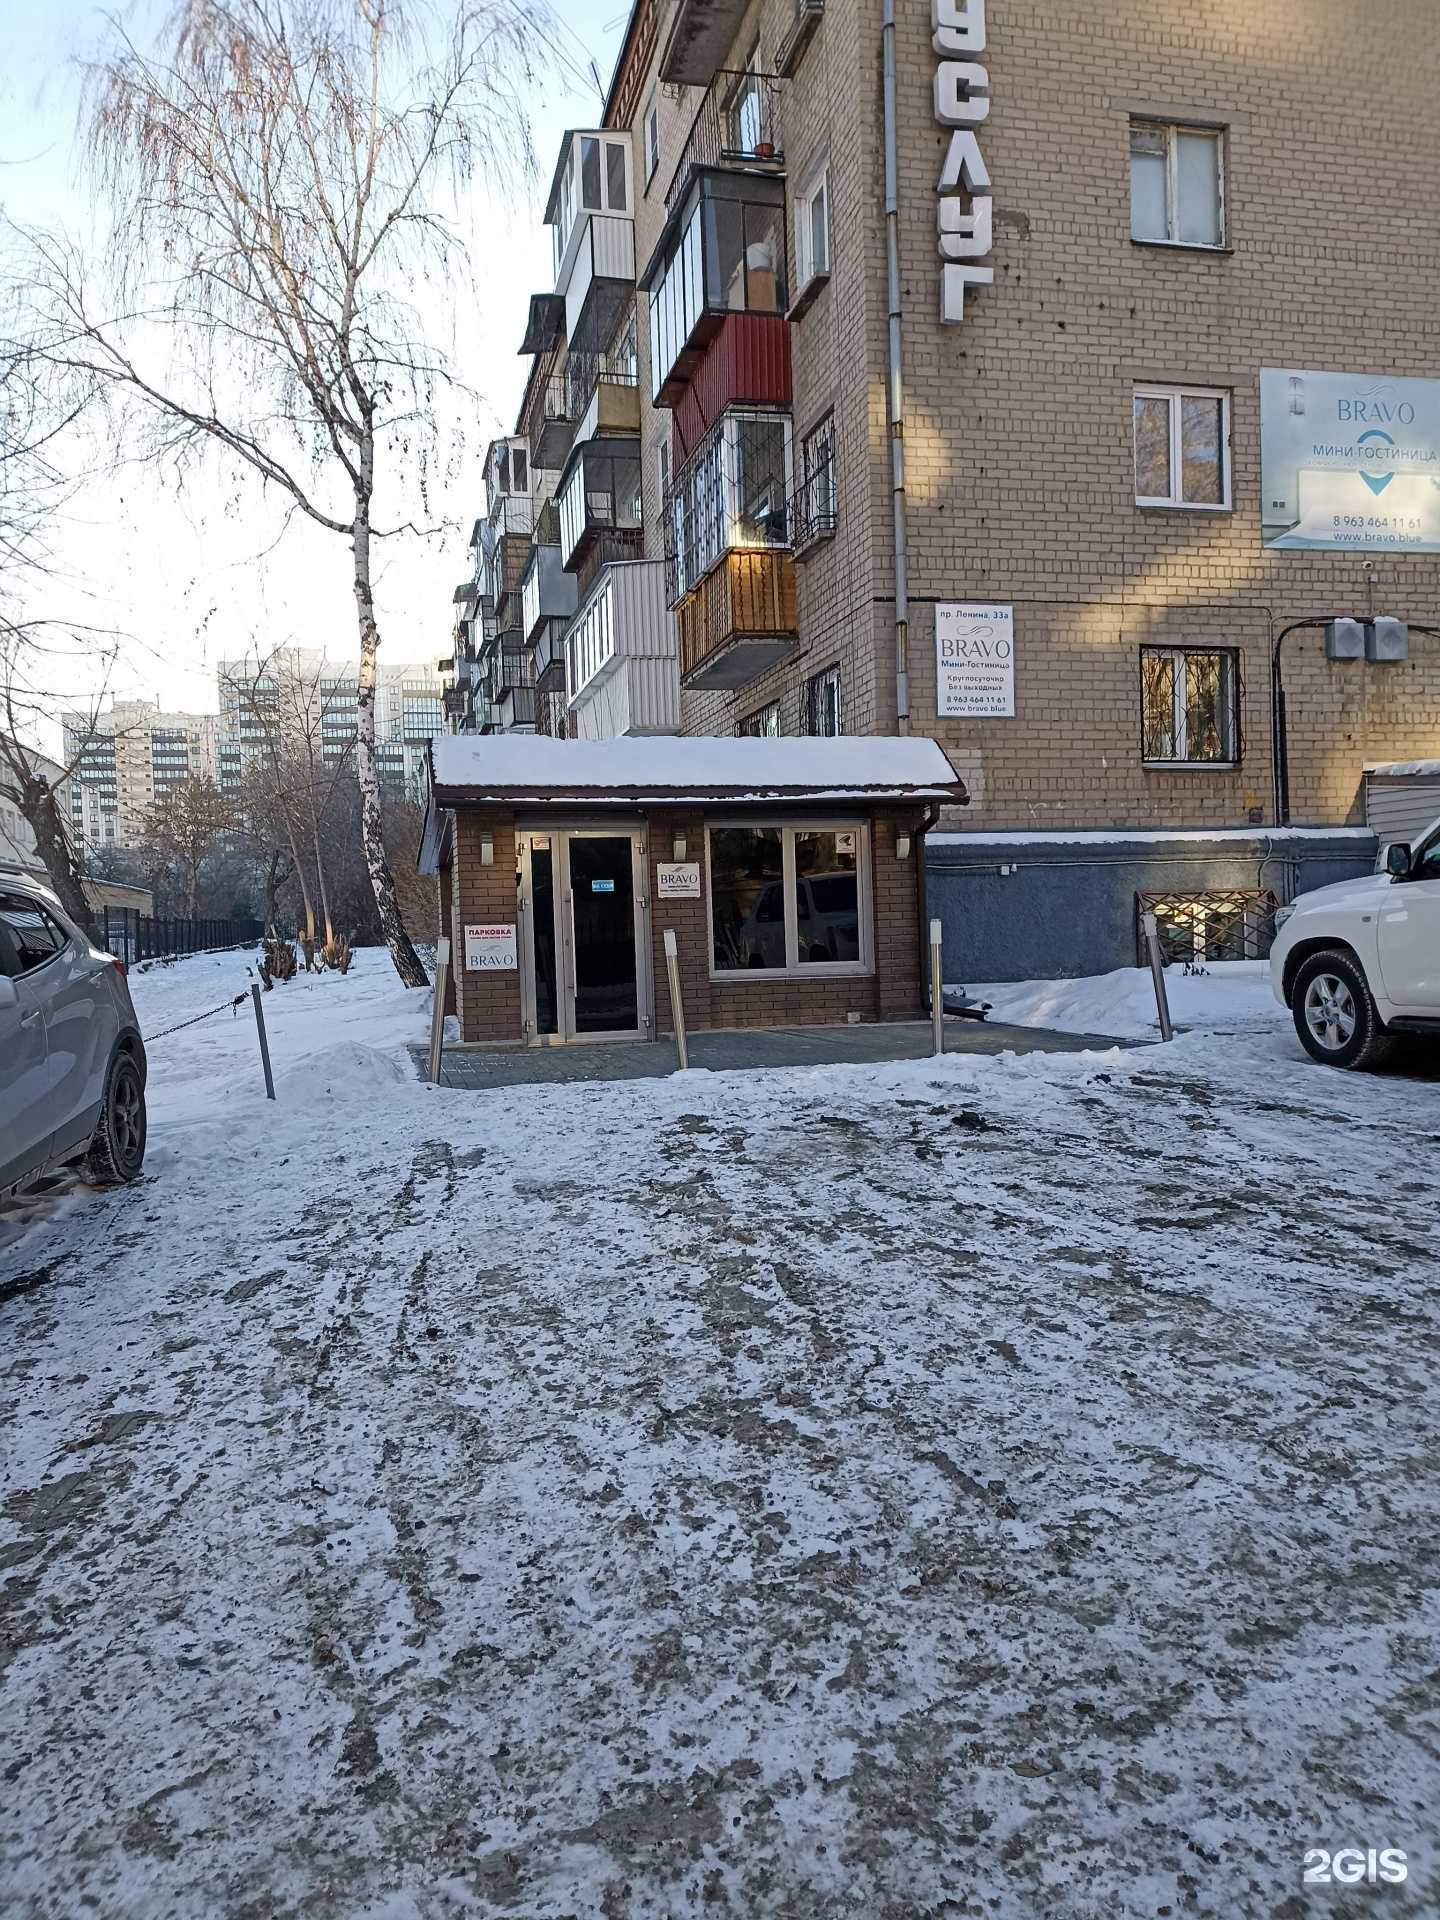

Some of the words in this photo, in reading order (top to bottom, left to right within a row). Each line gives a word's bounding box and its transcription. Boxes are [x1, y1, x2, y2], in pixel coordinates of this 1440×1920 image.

[931, 0, 994, 325] УСЛУГ
[1338, 399, 1415, 424] BRAVO
[1313, 444, 1353, 457] МИНИ
[1358, 446, 1438, 462] ГОСТИНИЦА
[1333, 515, 1341, 526] 8
[1343, 516, 1364, 527] 963
[1367, 517, 1388, 527] 464
[1393, 517, 1404, 528] 11
[1408, 518, 1421, 528] 61
[1334, 531, 1423, 543] www.bravo.blue
[993, 611, 1009, 619] 33а
[942, 639, 1010, 659] BRAVO
[941, 660, 1010, 669] Мини-Гостиница
[661, 874, 697, 884] BRAVO
[471, 954, 513, 966] BRAVO
